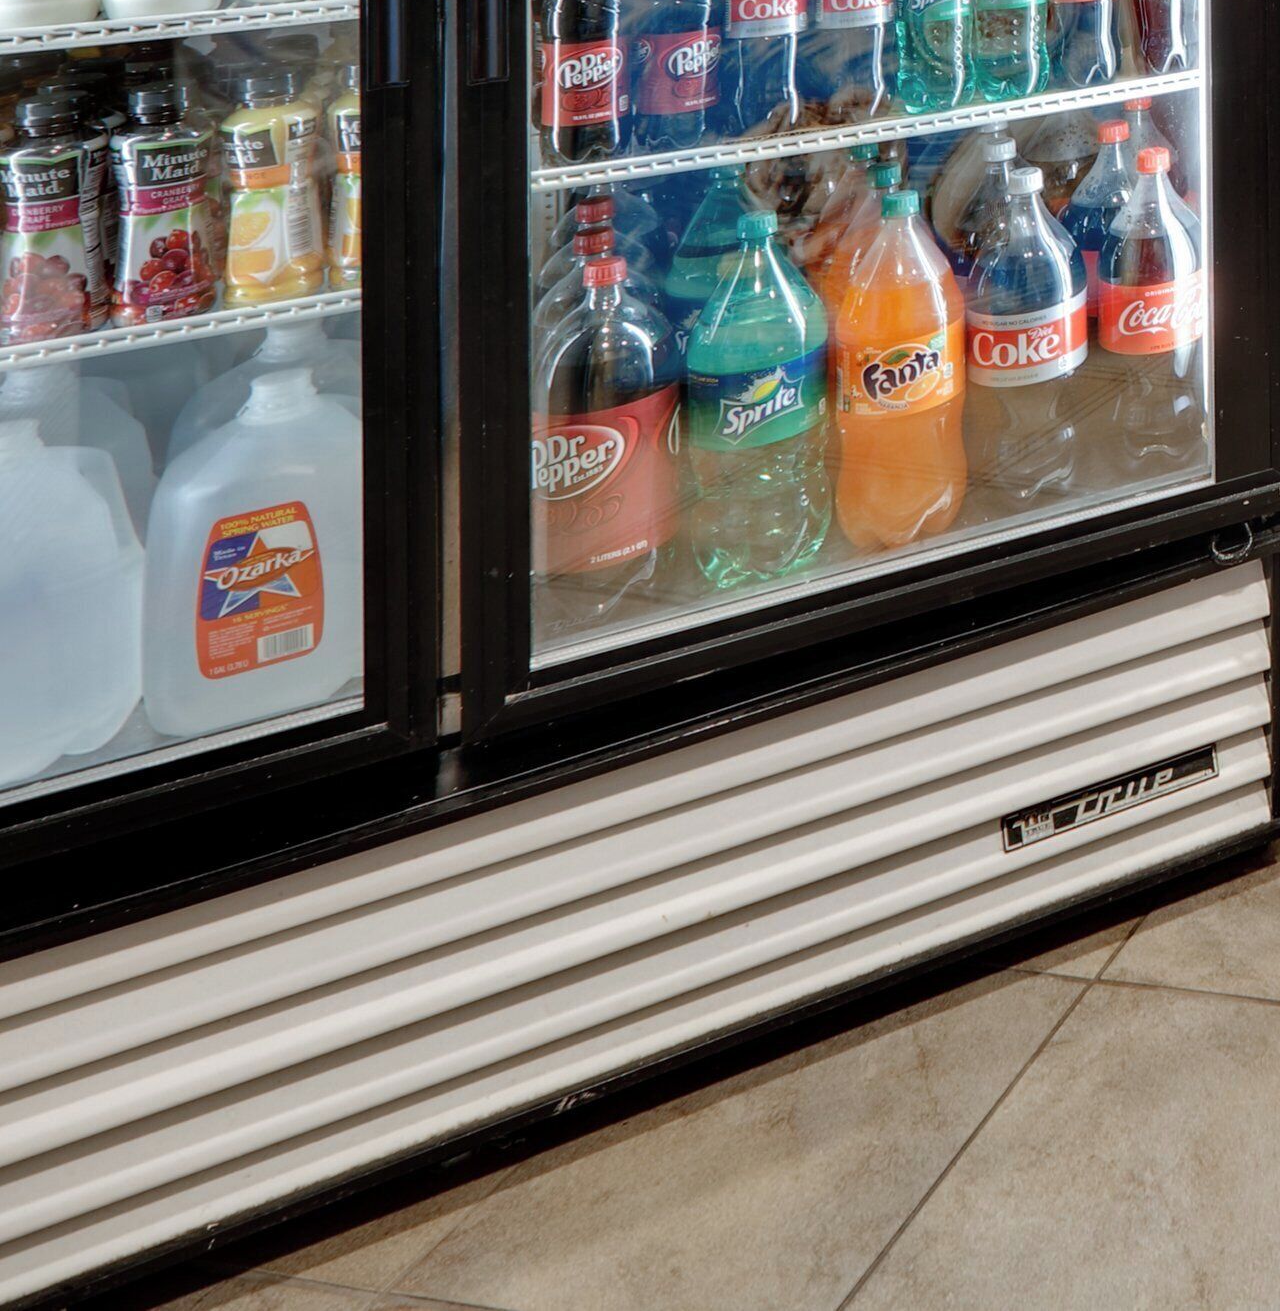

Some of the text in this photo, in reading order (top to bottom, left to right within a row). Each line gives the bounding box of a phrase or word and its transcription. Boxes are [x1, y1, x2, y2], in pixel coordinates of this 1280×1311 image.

[691, 39, 711, 55] Dr
[557, 54, 621, 89] Pepper
[580, 51, 607, 71] Dr
[669, 43, 720, 77] Pepper
[142, 149, 207, 168] Minute
[150, 161, 200, 181] Maid
[151, 183, 200, 198] CRANBERRY
[1027, 324, 1055, 340] Diet
[972, 331, 1061, 368] Coke
[862, 349, 939, 399] Fanta
[722, 382, 797, 435] Sprite
[548, 435, 586, 460] Dr
[532, 440, 616, 493] Pepper
[220, 507, 298, 531] 100% NATURAL
[222, 515, 295, 539] SPRING WATER
[590, 556, 597, 565] 2
[598, 550, 622, 563] LITERS
[216, 550, 301, 590] Ozarka
